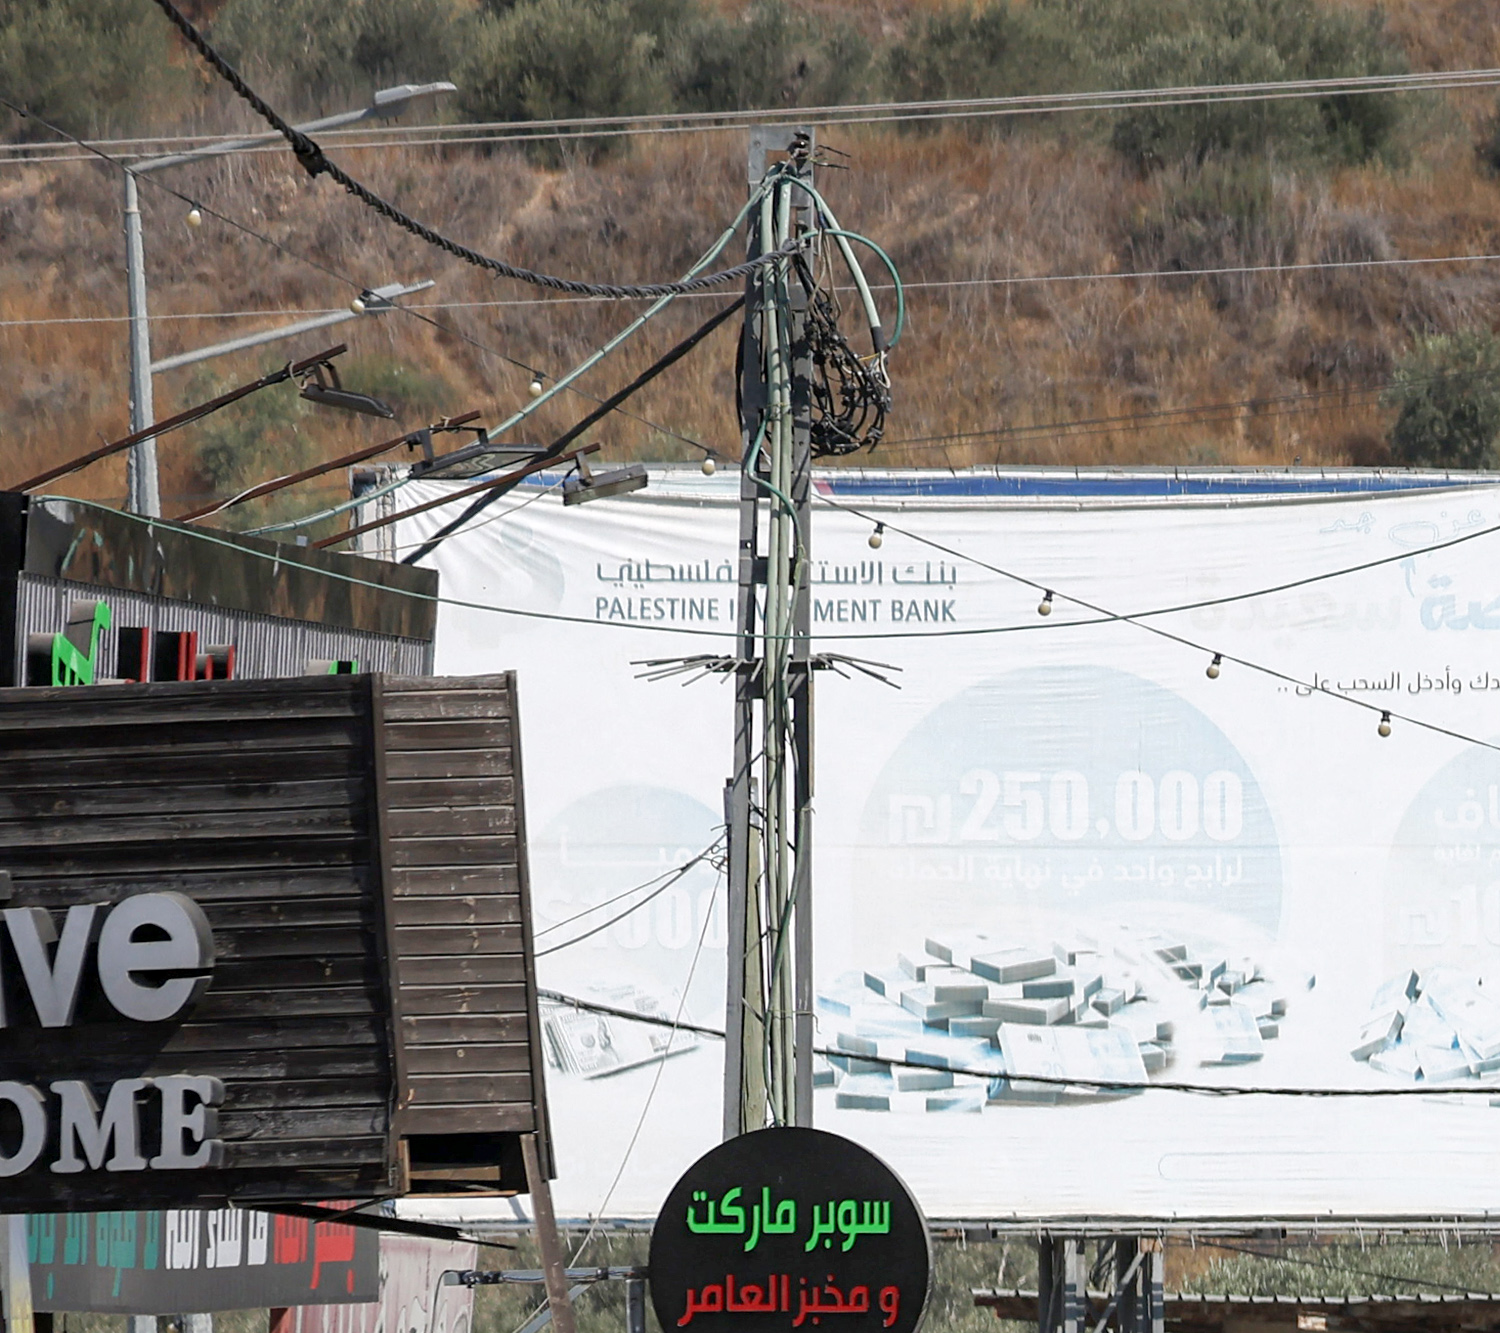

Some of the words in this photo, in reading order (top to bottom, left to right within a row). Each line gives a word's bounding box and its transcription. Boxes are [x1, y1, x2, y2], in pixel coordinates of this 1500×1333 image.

[596, 558, 737, 588] فلسطيني
[891, 561, 957, 590] بنك
[596, 597, 719, 621] PALESTINE
[891, 598, 956, 622] BANK
[1335, 668, 1402, 694] السحب
[1407, 666, 1463, 694] وأدخل
[985, 854, 1051, 889] نهاية
[1061, 860, 1104, 895] في
[1113, 856, 1175, 885] واحد
[1183, 855, 1243, 888] لرابح
[686, 1187, 797, 1252] ماركت
[805, 1198, 892, 1252] سوبر
[677, 1274, 789, 1327] العامر
[792, 1275, 870, 1327] مخبز
[879, 1285, 900, 1327] و
